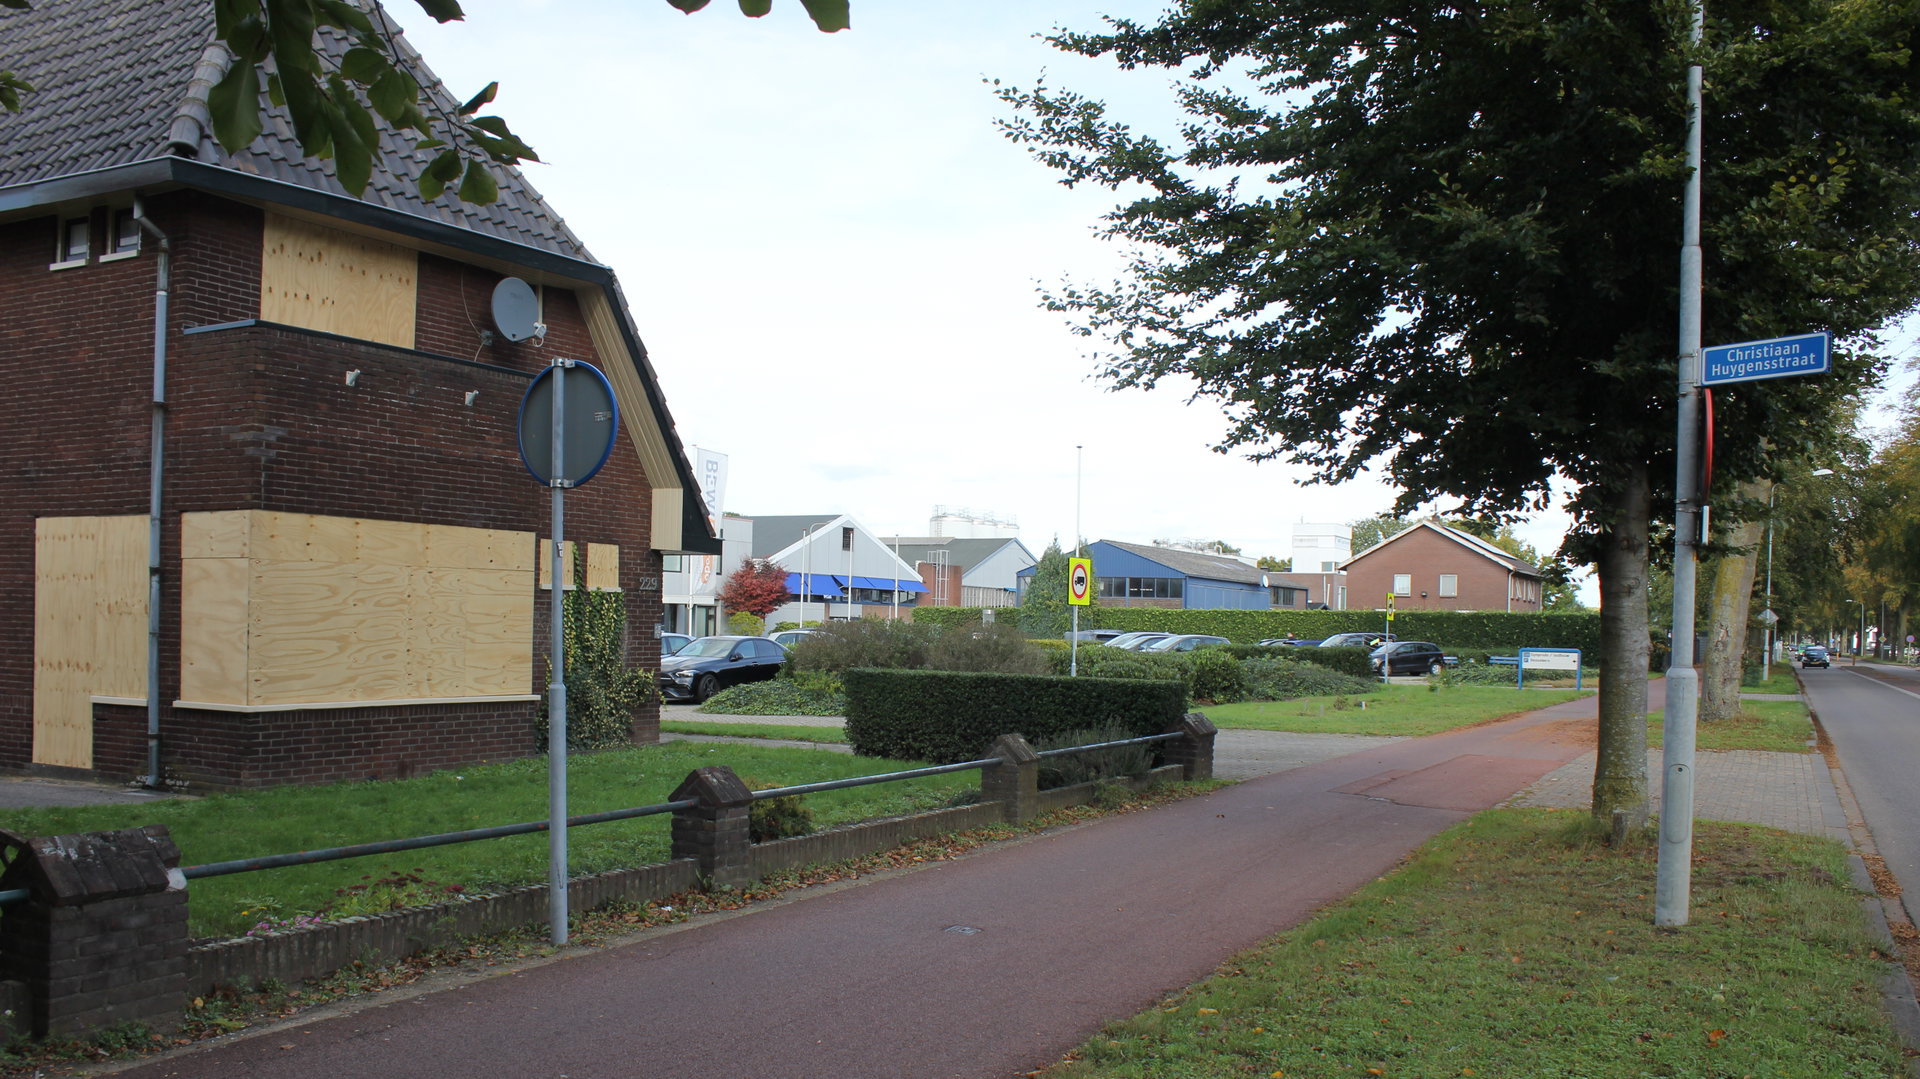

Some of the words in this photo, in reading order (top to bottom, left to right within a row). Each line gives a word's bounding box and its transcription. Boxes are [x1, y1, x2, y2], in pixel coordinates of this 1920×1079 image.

[1727, 343, 1800, 362] Christiaan
[1711, 352, 1816, 378] Huygensstraat
[639, 577, 657, 590] 229
